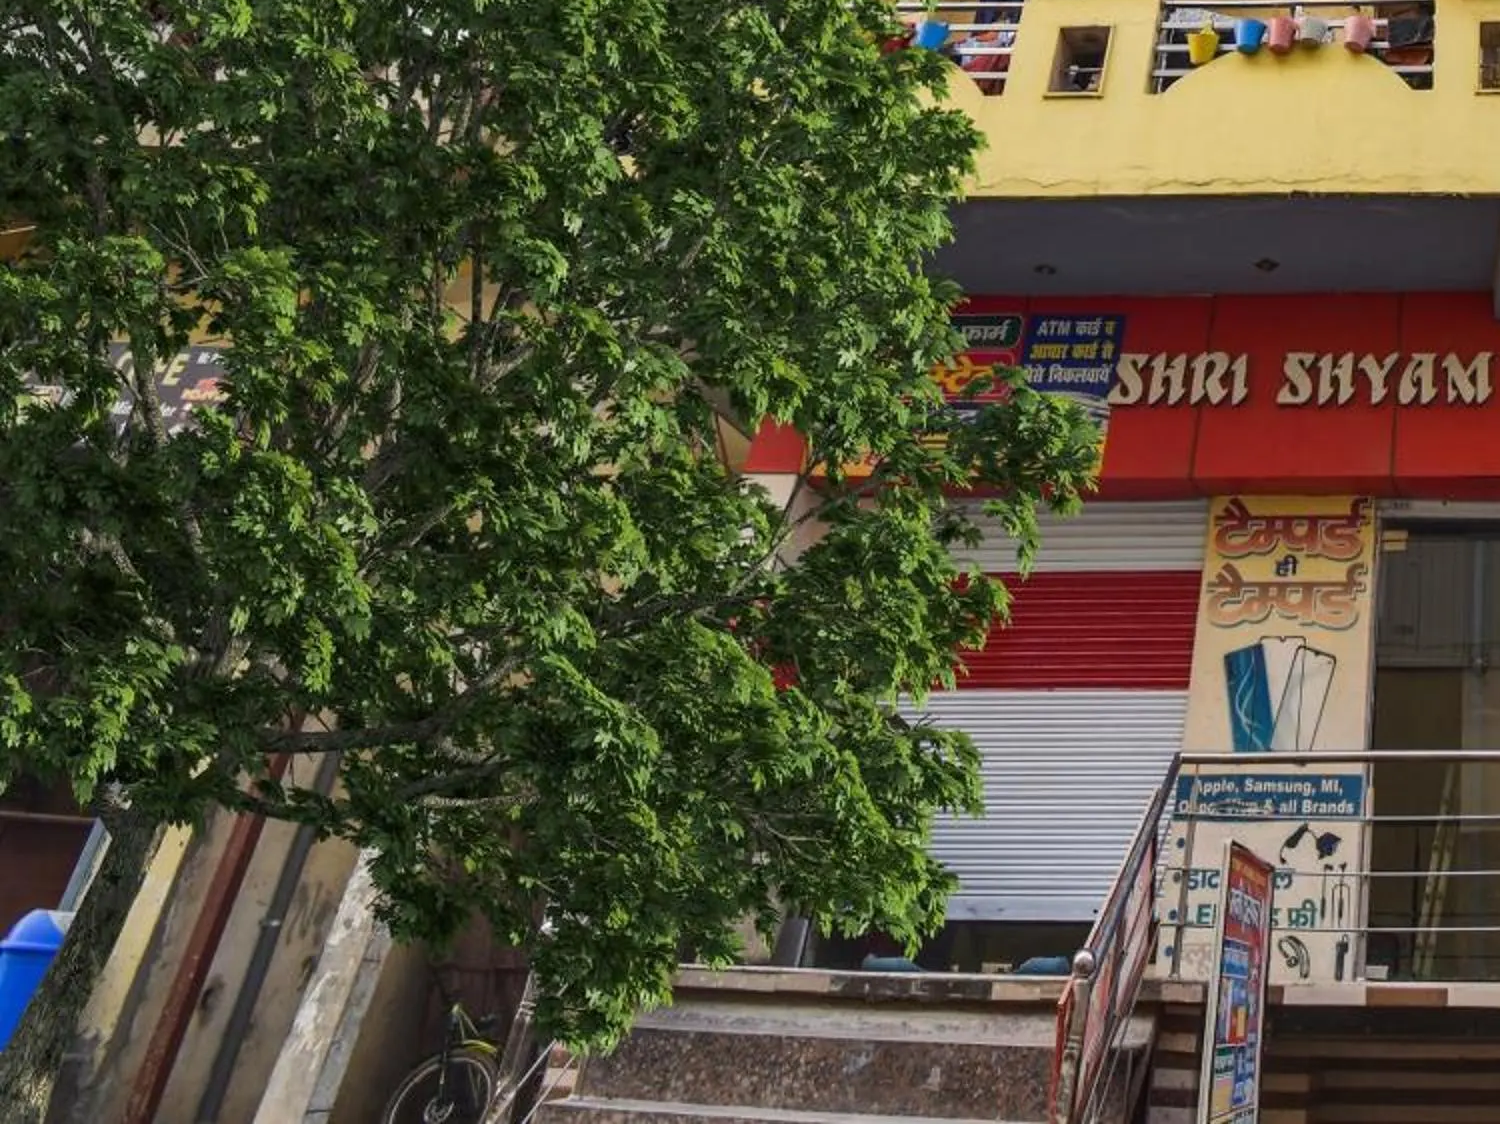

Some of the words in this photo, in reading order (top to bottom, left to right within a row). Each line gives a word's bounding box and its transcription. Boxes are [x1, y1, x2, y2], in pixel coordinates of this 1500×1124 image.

[1037, 319, 1071, 336] ATM
[1107, 350, 1249, 406] SHRI
[1276, 350, 1494, 406] SHYAM
[1275, 555, 1298, 576] ही
[1244, 777, 1316, 794] Samsung,
[1279, 800, 1297, 814] all
[1301, 799, 1355, 814] Brands
